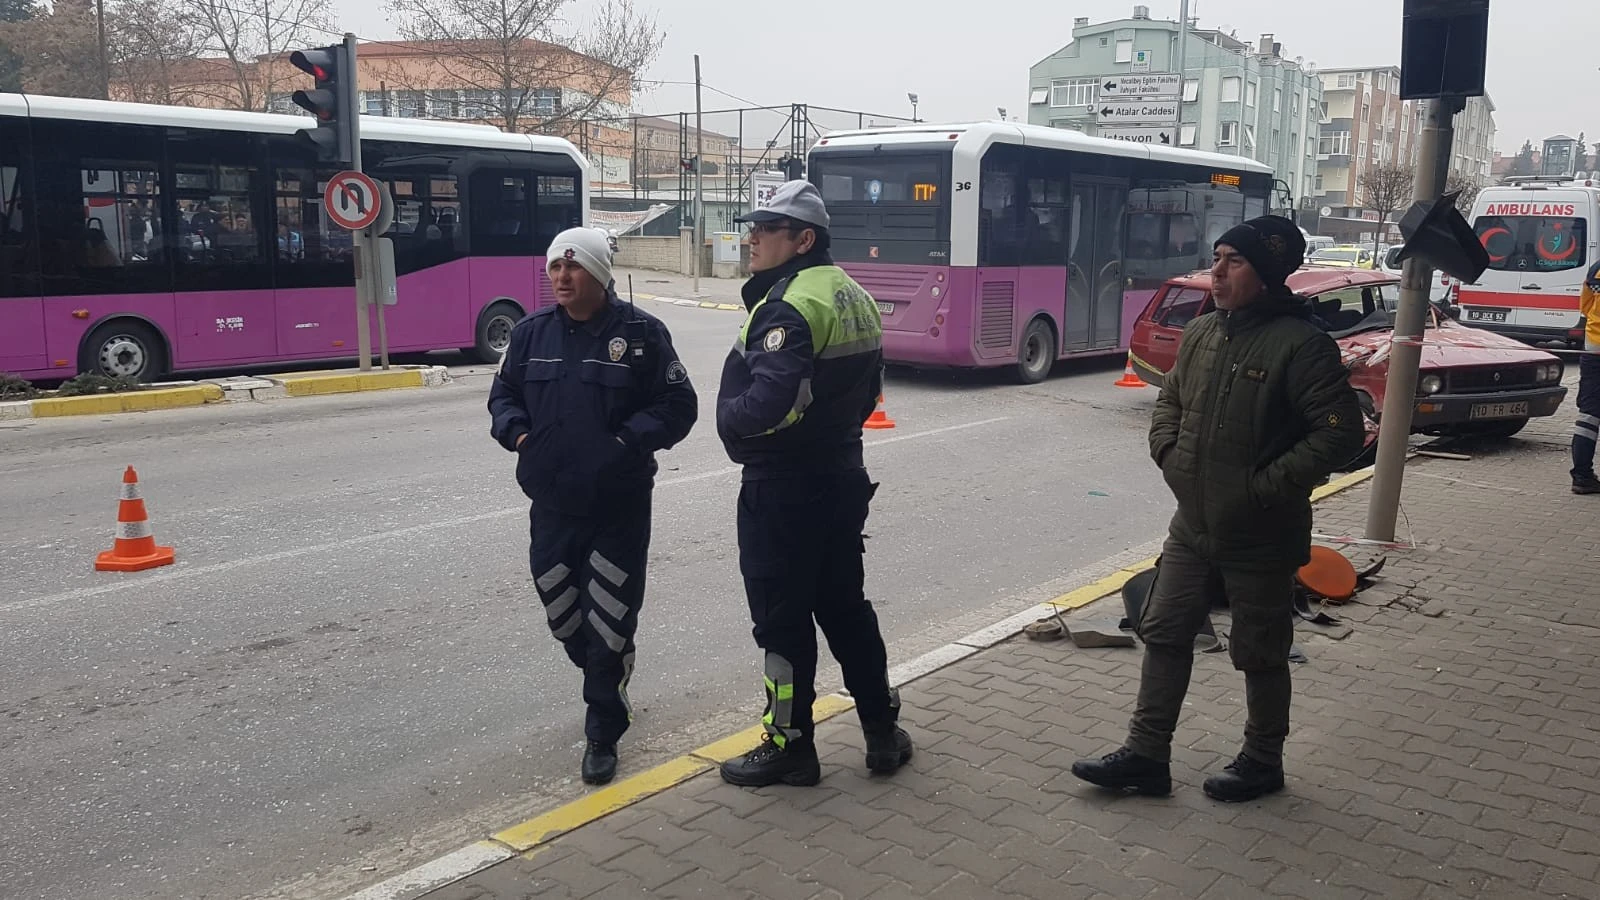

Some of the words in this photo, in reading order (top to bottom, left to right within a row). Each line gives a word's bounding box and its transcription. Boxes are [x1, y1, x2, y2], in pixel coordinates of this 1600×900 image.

[1115, 107, 1140, 116] Atalar
[1141, 106, 1175, 116] Caddesi
[955, 181, 972, 192] 36
[1486, 203, 1575, 216] AMBULANS
[1476, 406, 1487, 416] 10
[1510, 404, 1526, 414] 464
